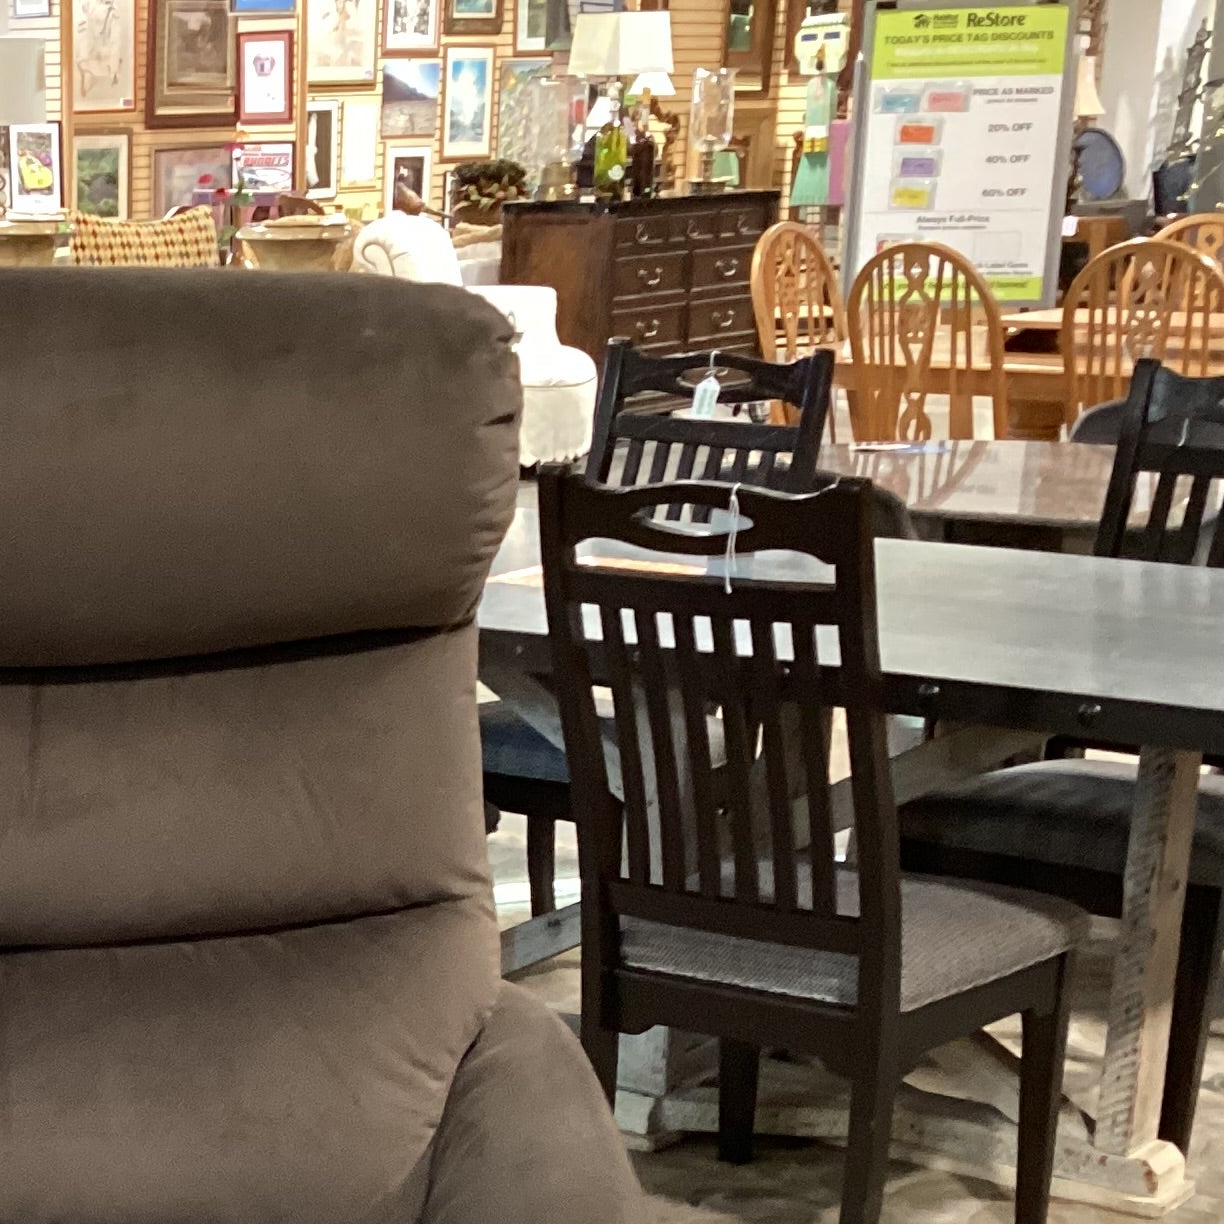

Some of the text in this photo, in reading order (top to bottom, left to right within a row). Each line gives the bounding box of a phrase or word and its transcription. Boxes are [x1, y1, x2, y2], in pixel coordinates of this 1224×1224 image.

[966, 12, 1026, 28] ReStore
[884, 30, 1054, 45] TODAY'S PRICE TAG DISCOUNTS
[972, 86, 1054, 96] PRICE AS MARKED
[988, 123, 1033, 132] 20% OFF
[985, 154, 1031, 163] 40% OFF
[1006, 188, 1027, 196] OFF
